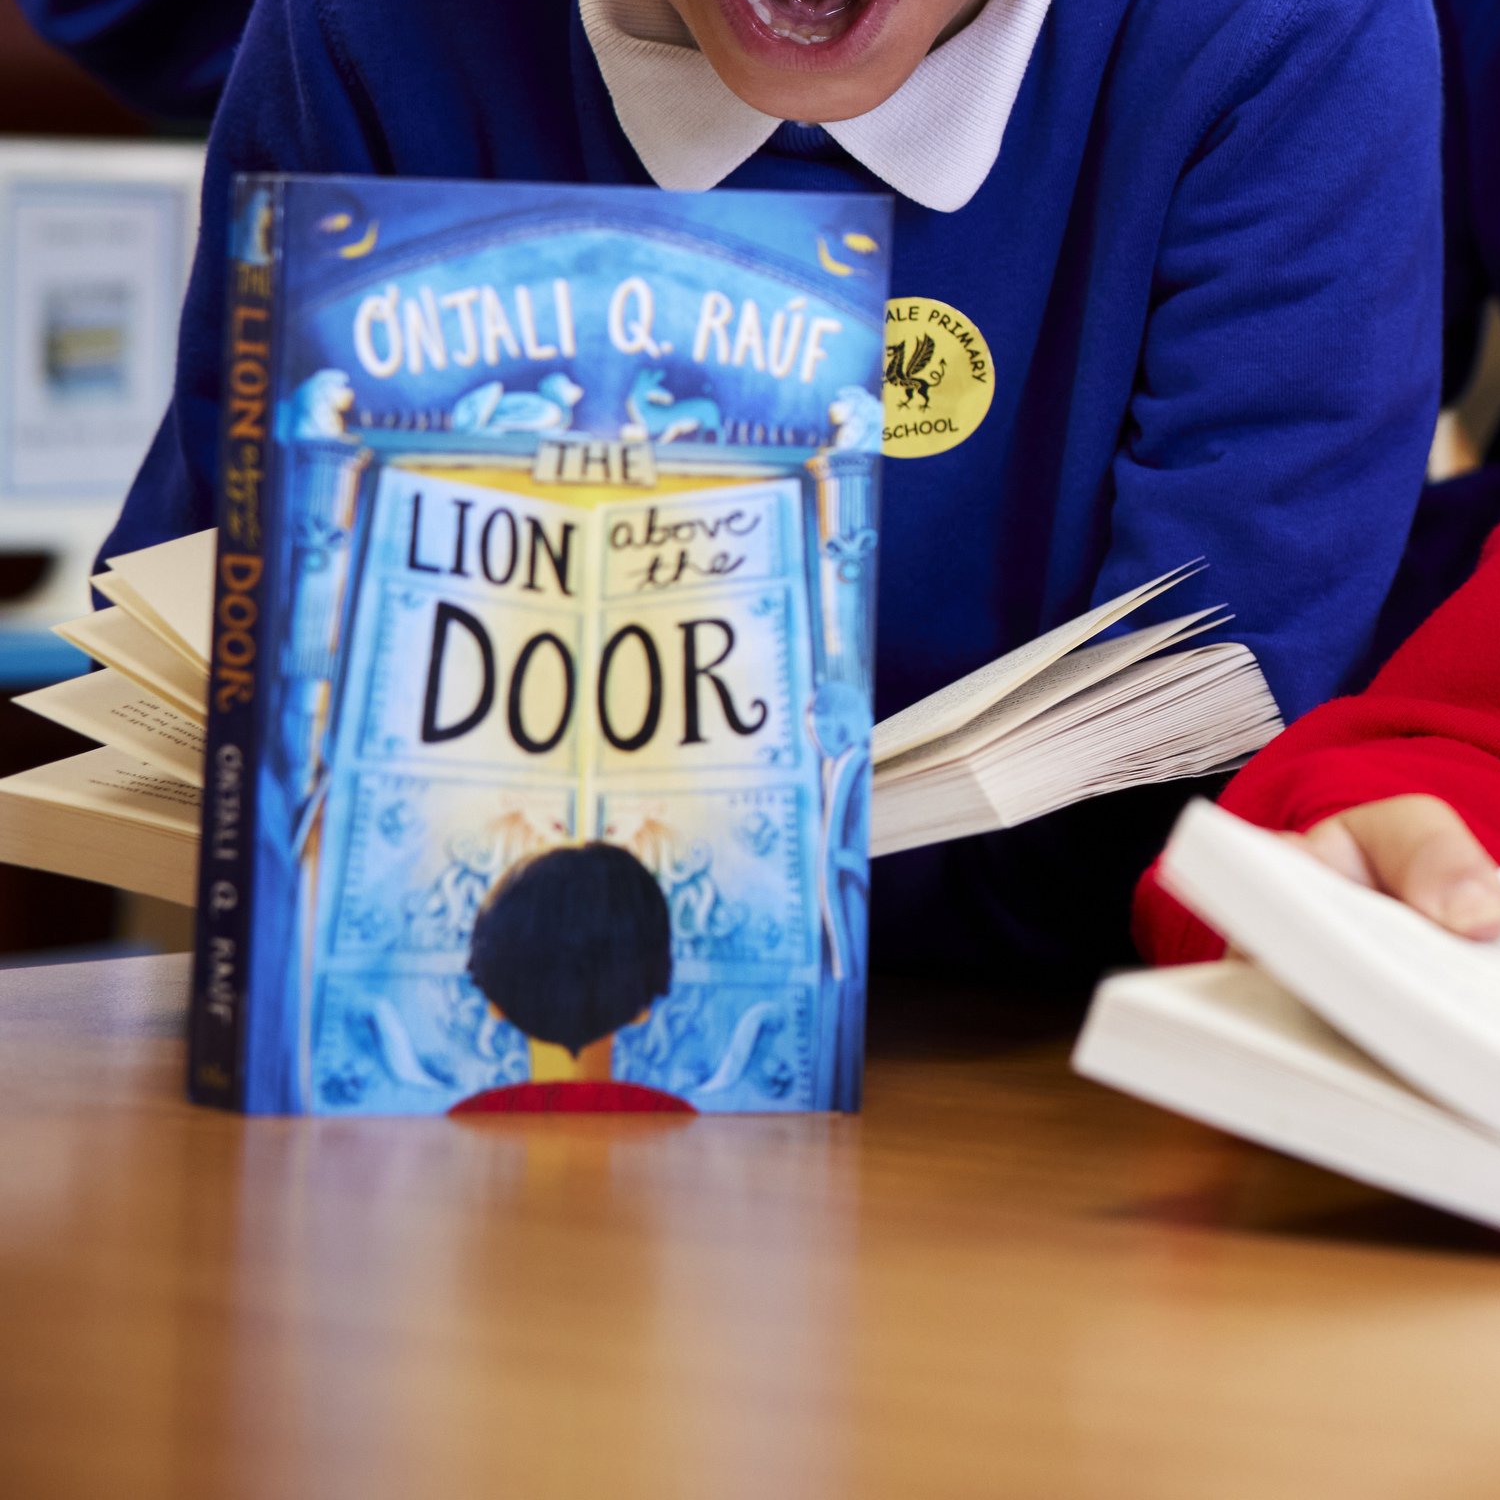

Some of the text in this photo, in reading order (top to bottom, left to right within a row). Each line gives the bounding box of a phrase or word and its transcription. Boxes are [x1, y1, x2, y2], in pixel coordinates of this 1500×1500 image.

[606, 275, 674, 359] Q.
[885, 305, 987, 384] ALE PRIMARY
[228, 306, 270, 439] LION
[539, 441, 644, 485] THE
[882, 417, 959, 442] SCHOOL
[406, 491, 763, 596] LION above
[622, 549, 746, 591] the
[216, 552, 263, 714] DOOR
[420, 600, 768, 755] DOOR
